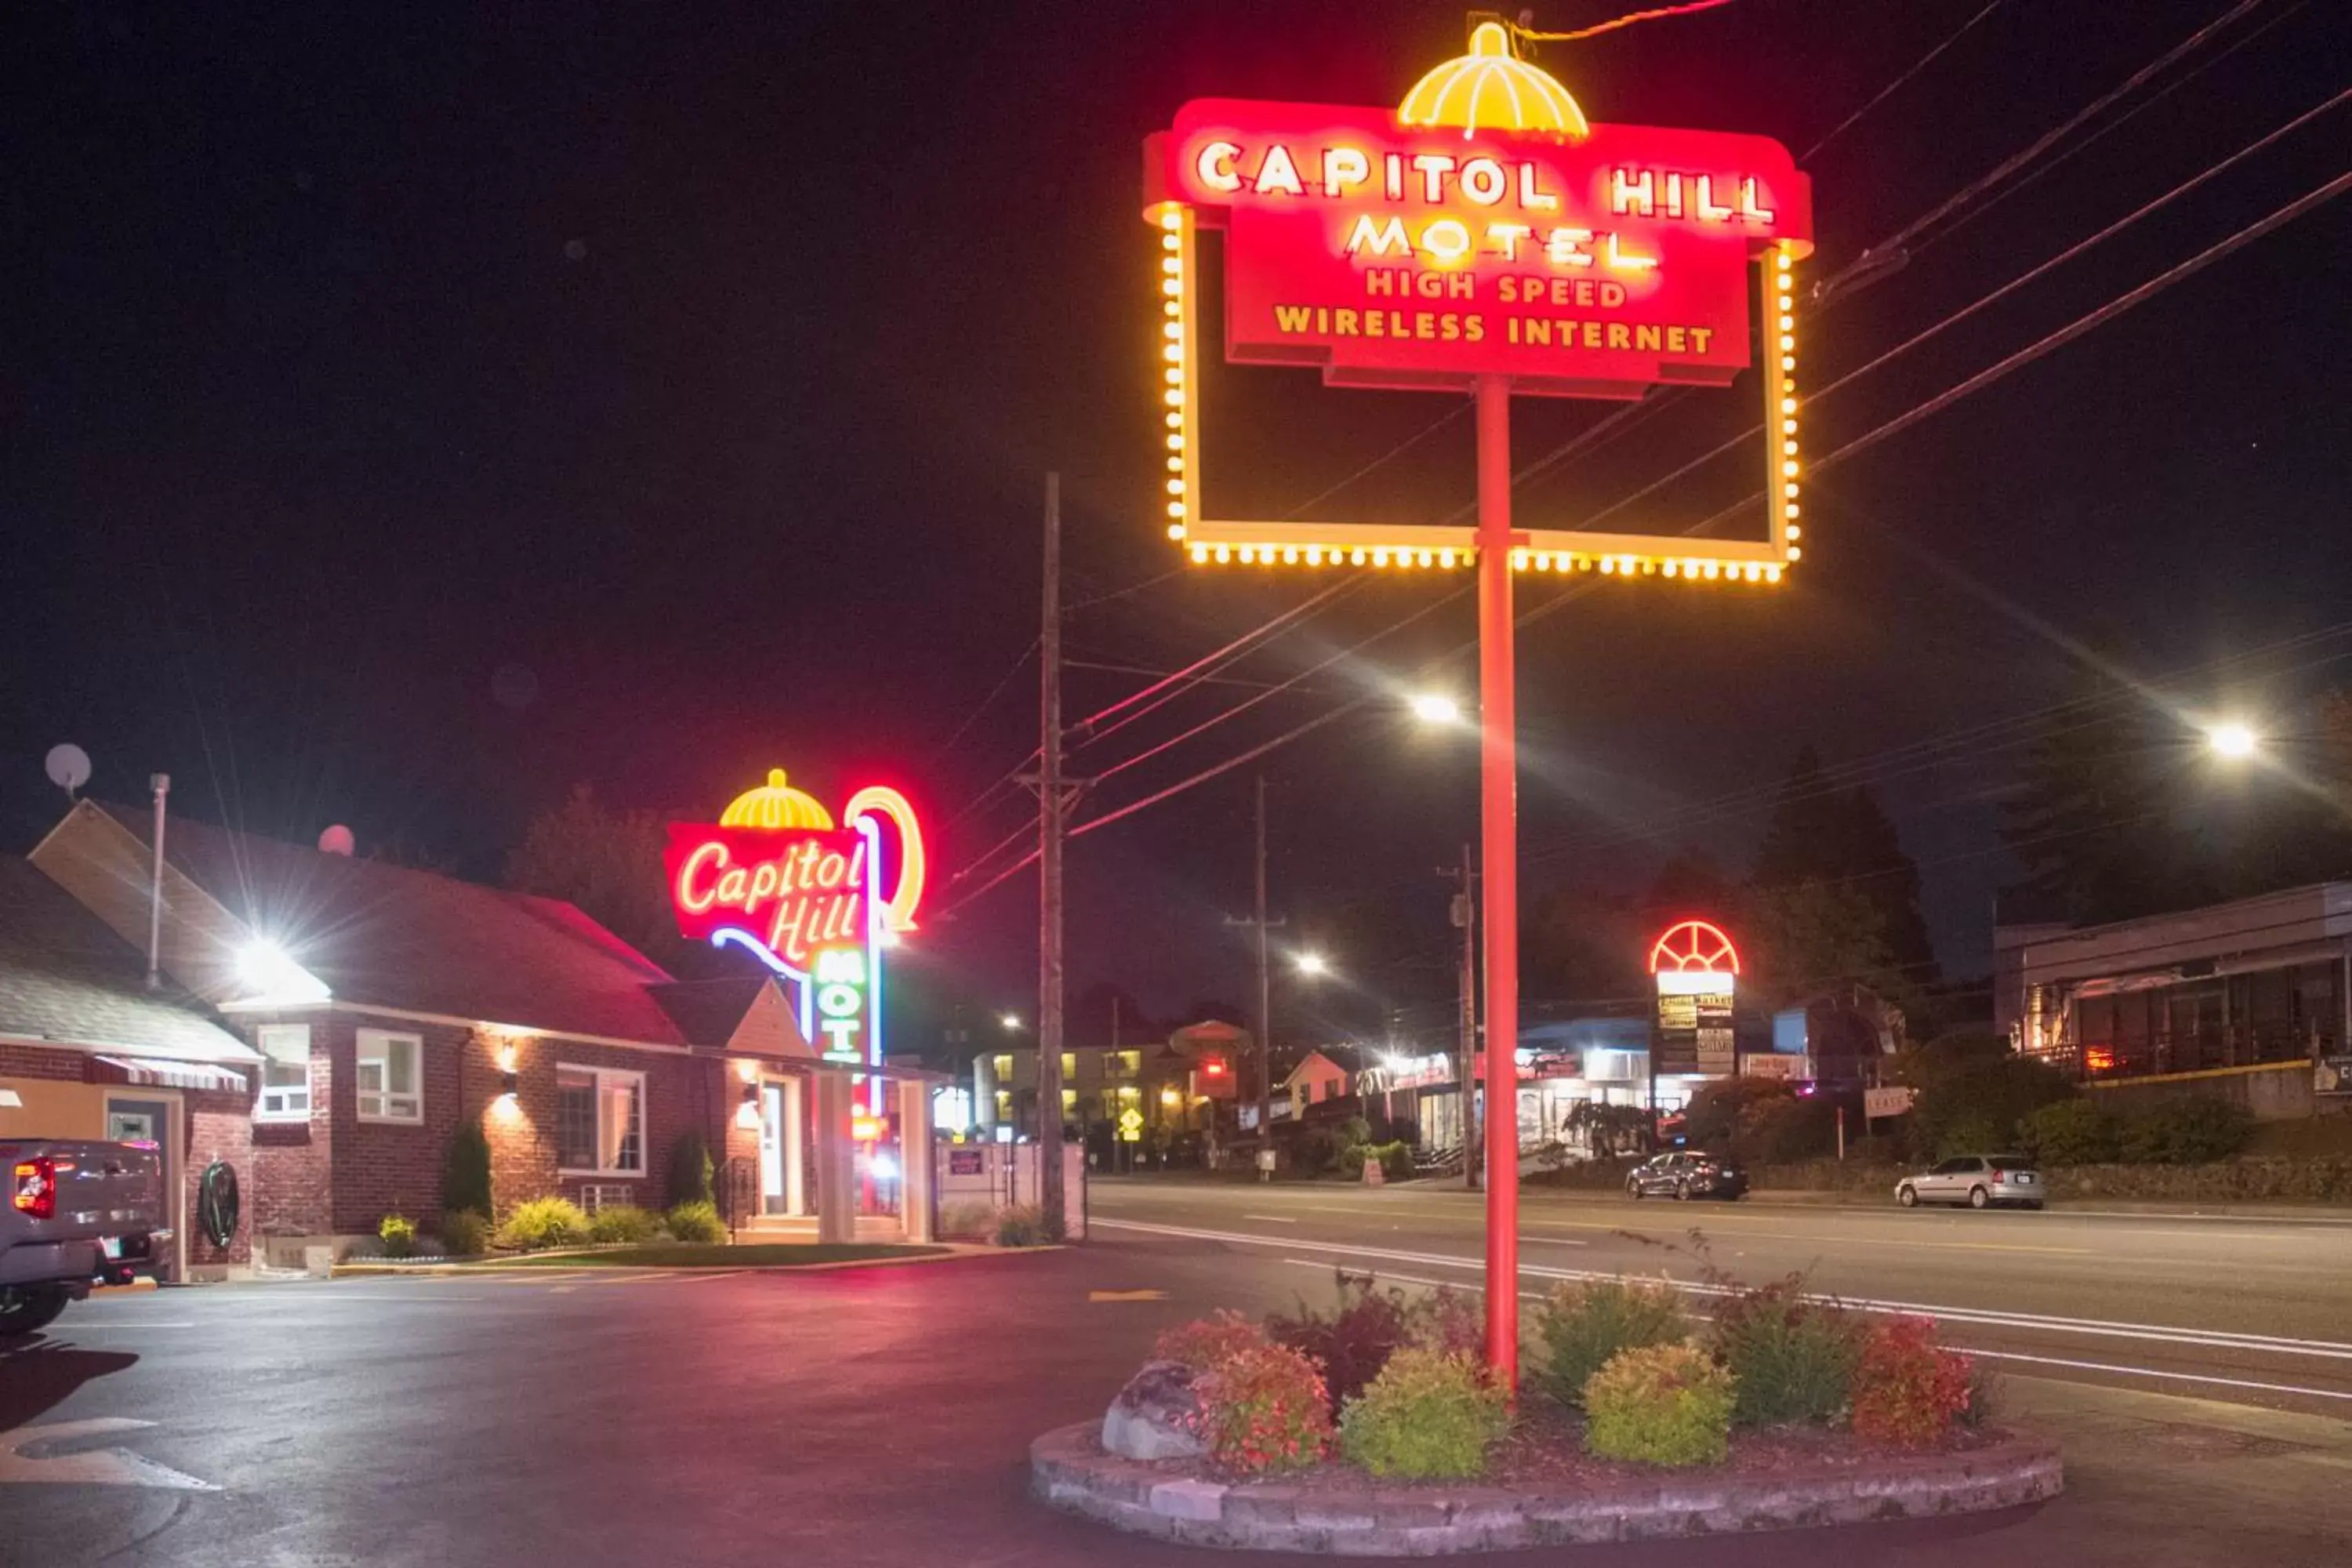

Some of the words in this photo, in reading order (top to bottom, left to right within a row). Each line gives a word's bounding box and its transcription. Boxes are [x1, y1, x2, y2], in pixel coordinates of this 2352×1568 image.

[1196, 141, 1559, 209] CAPITOL
[1611, 167, 1775, 224] HILL
[1344, 214, 1660, 268] MOTEL
[1366, 268, 1475, 299] HIGH
[1498, 275, 1626, 308] SPEED
[1274, 305, 1486, 342] WIRELESS
[1508, 316, 1712, 354] INTERNET
[681, 839, 865, 915] Capitol
[769, 892, 859, 961] Hill
